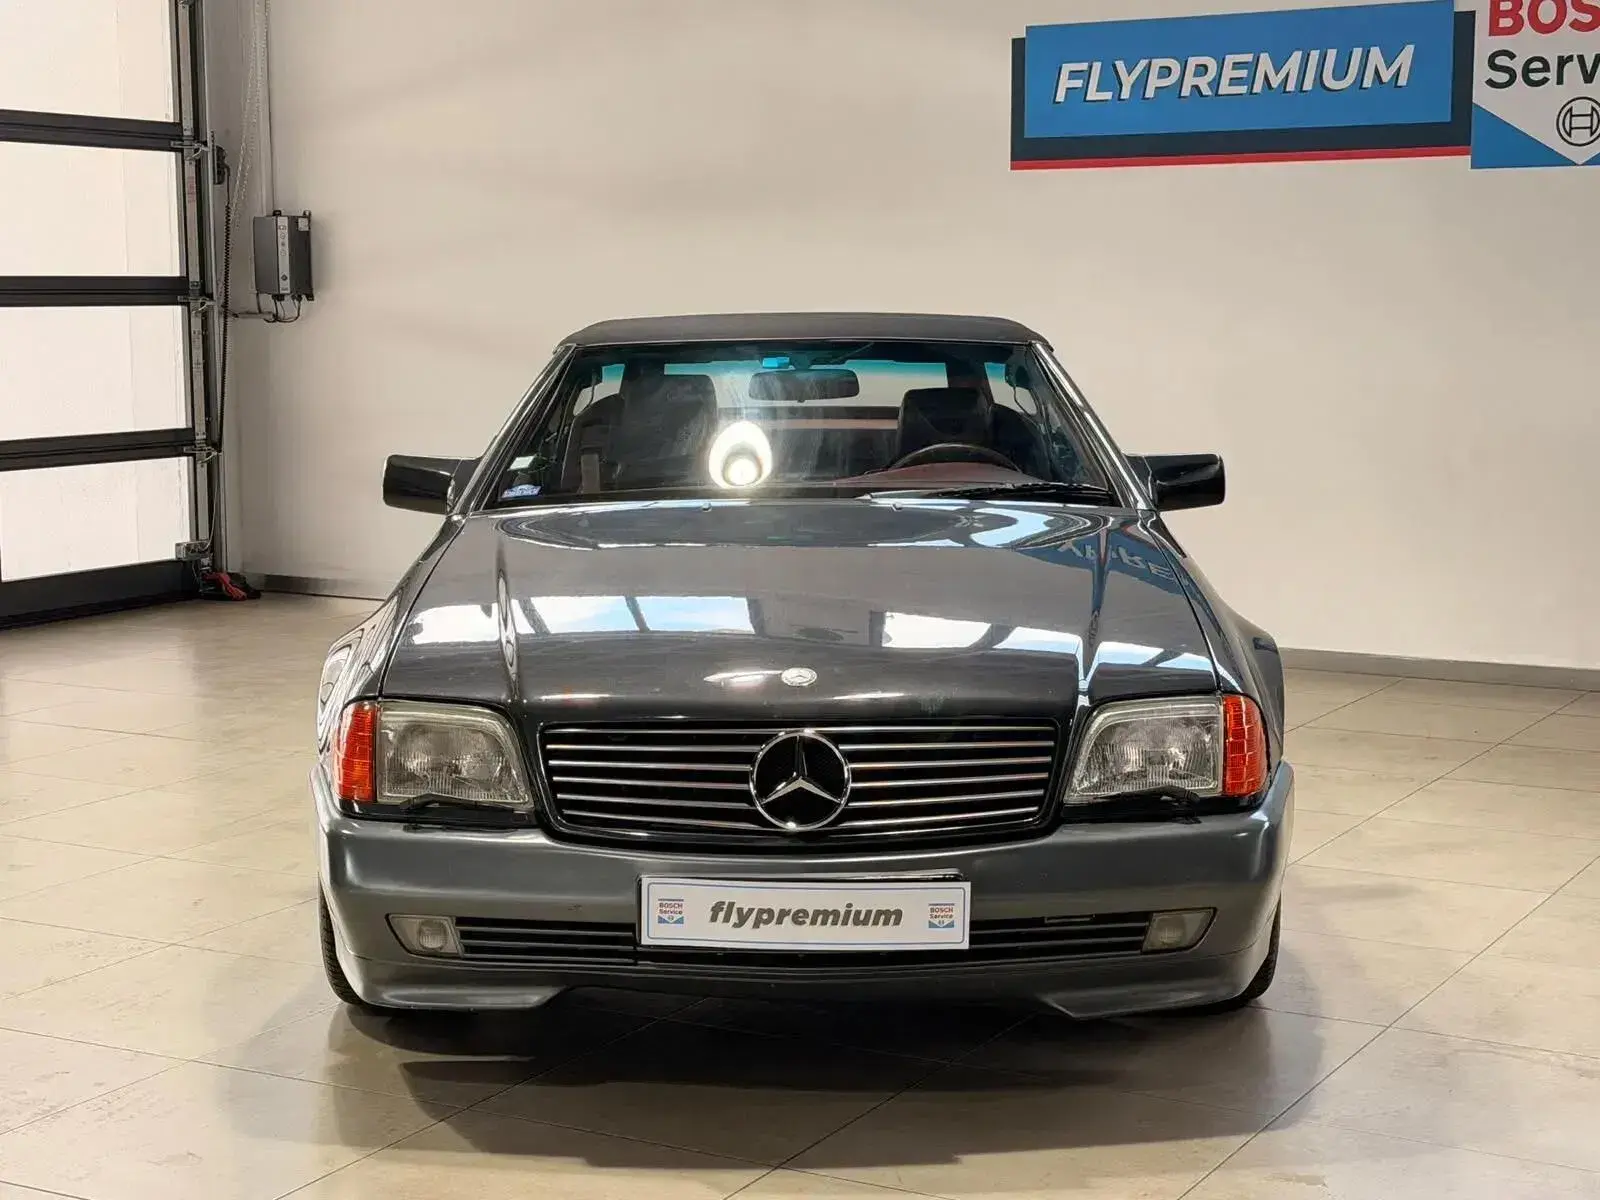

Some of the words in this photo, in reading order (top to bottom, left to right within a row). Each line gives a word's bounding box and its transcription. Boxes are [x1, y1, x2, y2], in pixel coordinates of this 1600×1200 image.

[1054, 44, 1415, 103] FLYPREMIUM
[1484, 49, 1600, 89] Serv
[709, 900, 903, 929] flypremium
